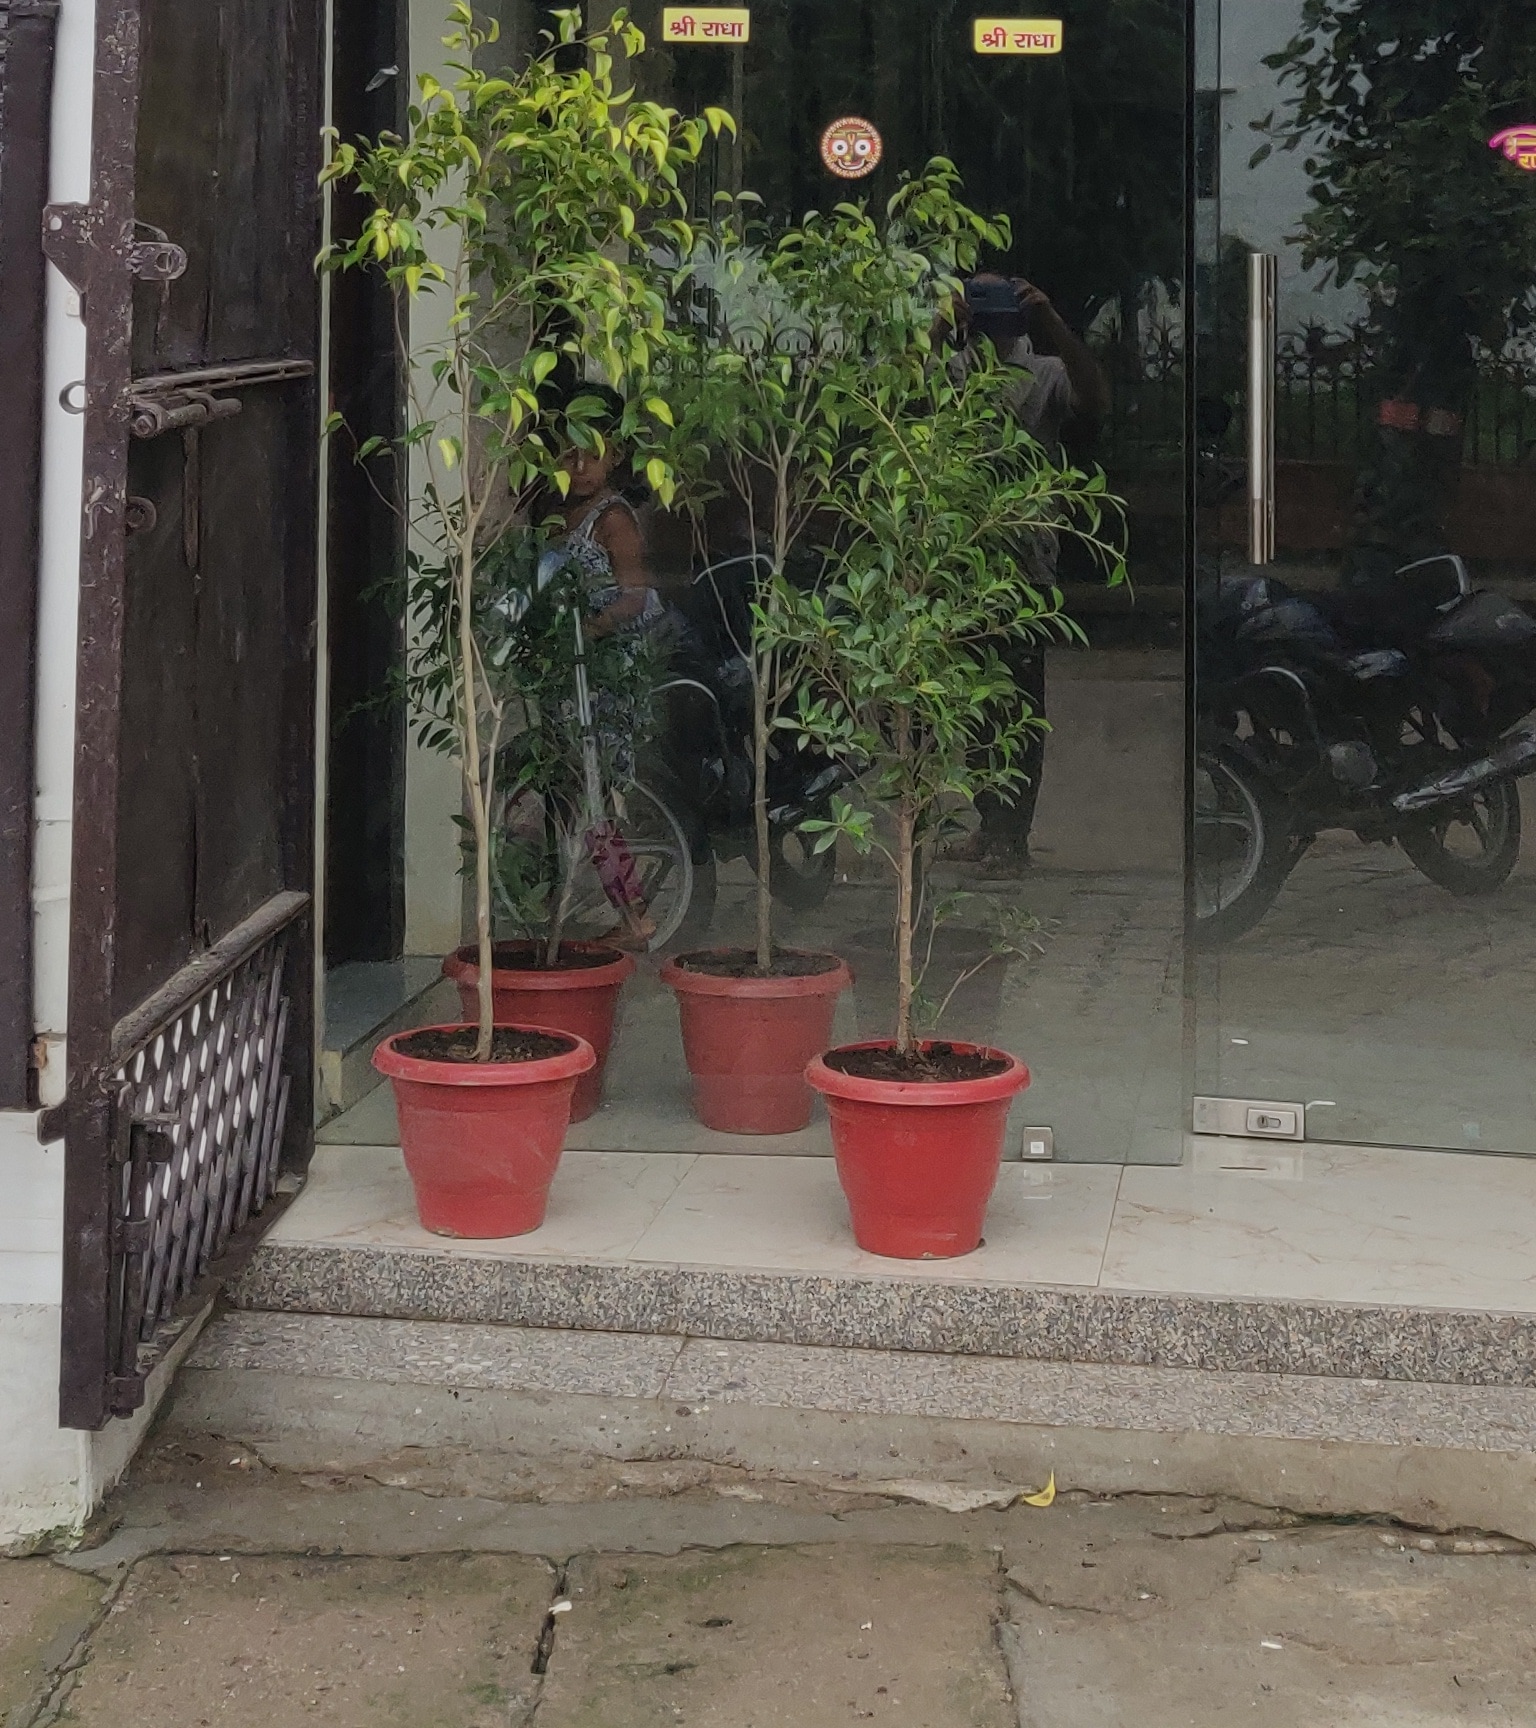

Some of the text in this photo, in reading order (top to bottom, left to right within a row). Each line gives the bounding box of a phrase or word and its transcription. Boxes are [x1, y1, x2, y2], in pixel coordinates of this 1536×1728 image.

[670, 15, 744, 37] श्री राधा
[981, 27, 1056, 48] श्री राधा
